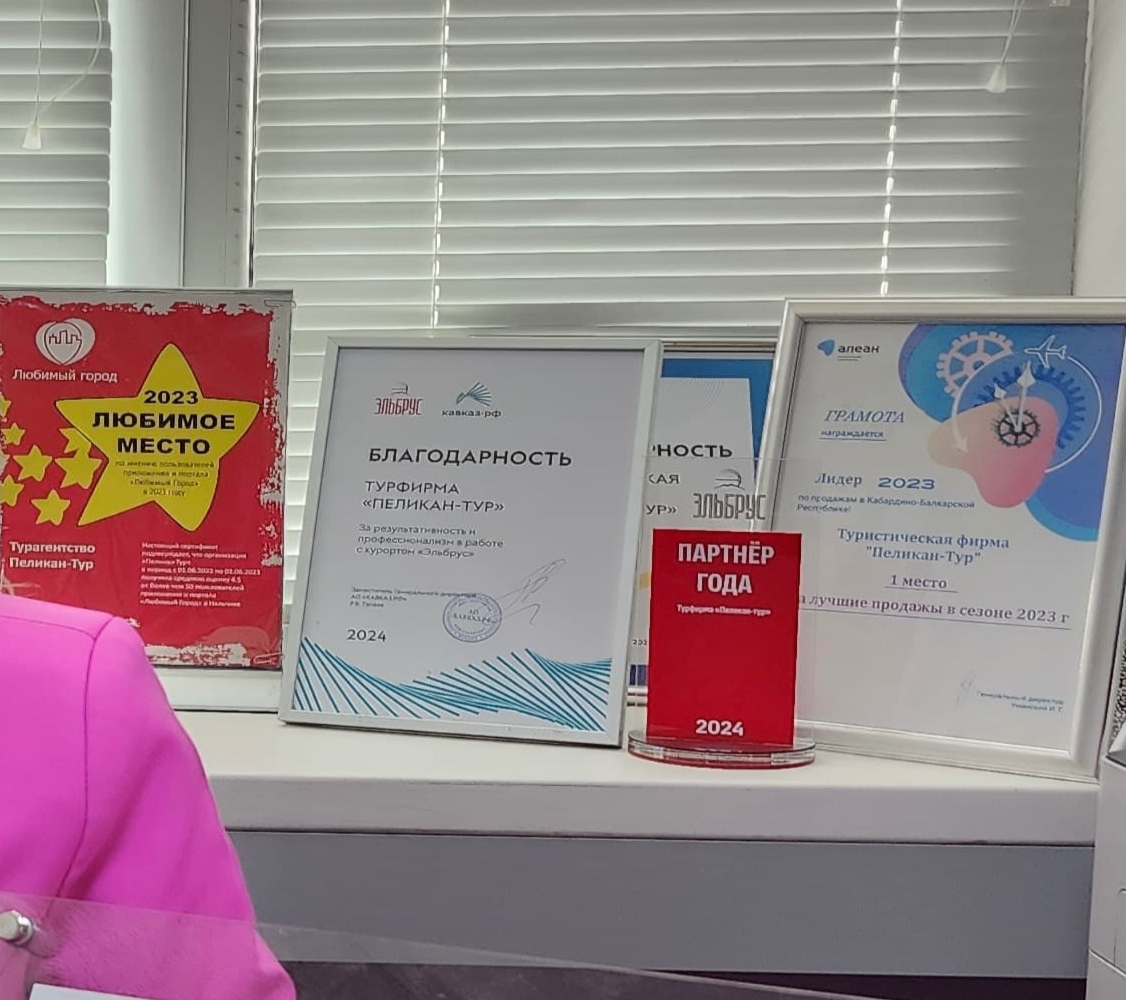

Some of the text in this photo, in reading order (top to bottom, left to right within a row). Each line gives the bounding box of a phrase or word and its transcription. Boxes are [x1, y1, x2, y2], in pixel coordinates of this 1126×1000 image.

[838, 345, 880, 354] алеан
[13, 369, 118, 383] Любимый город
[144, 390, 199, 405] 2023
[374, 398, 423, 416] ЭЛЬБРУС
[92, 412, 236, 430] ЛЮБИМОЕ
[824, 410, 906, 424] ГРАМОТА
[821, 430, 884, 438] награждается
[117, 438, 210, 455] МЕСТО
[652, 444, 733, 458] НОСТЬ
[369, 449, 572, 467] БЛАГОДАРНОСТЬ
[365, 481, 459, 494] ТУРФИРМА
[815, 473, 935, 490] Лидер 2023
[363, 498, 505, 513] «ПЕЛИКАН-ТУР»
[646, 504, 677, 515] УР»
[693, 493, 767, 520] ЭЛЬБРУС
[867, 496, 975, 509] Кабардино-Балкарской
[358, 524, 371, 532] За
[374, 525, 467, 535] результативность
[358, 536, 454, 546] профессионализм
[465, 538, 504, 548] работе
[838, 528, 1010, 550] Туристическая фирма
[9, 541, 96, 554] Турагентство
[364, 548, 415, 558] курортом
[417, 548, 475, 558] «Эльбрус»
[678, 541, 775, 565] ПАРТНЁР
[866, 545, 981, 566] "Пеликан-Тур"
[9, 556, 94, 571] Пеликан-Тур
[697, 573, 752, 596] ГОДА
[891, 575, 947, 589] 1 место
[677, 603, 714, 614] Турфирма
[809, 594, 868, 608] лучшие
[947, 606, 955, 615] в
[960, 607, 1012, 620] сезоне
[1017, 608, 1057, 623] 2023
[347, 629, 387, 642] 2024
[695, 719, 744, 736] 2024
